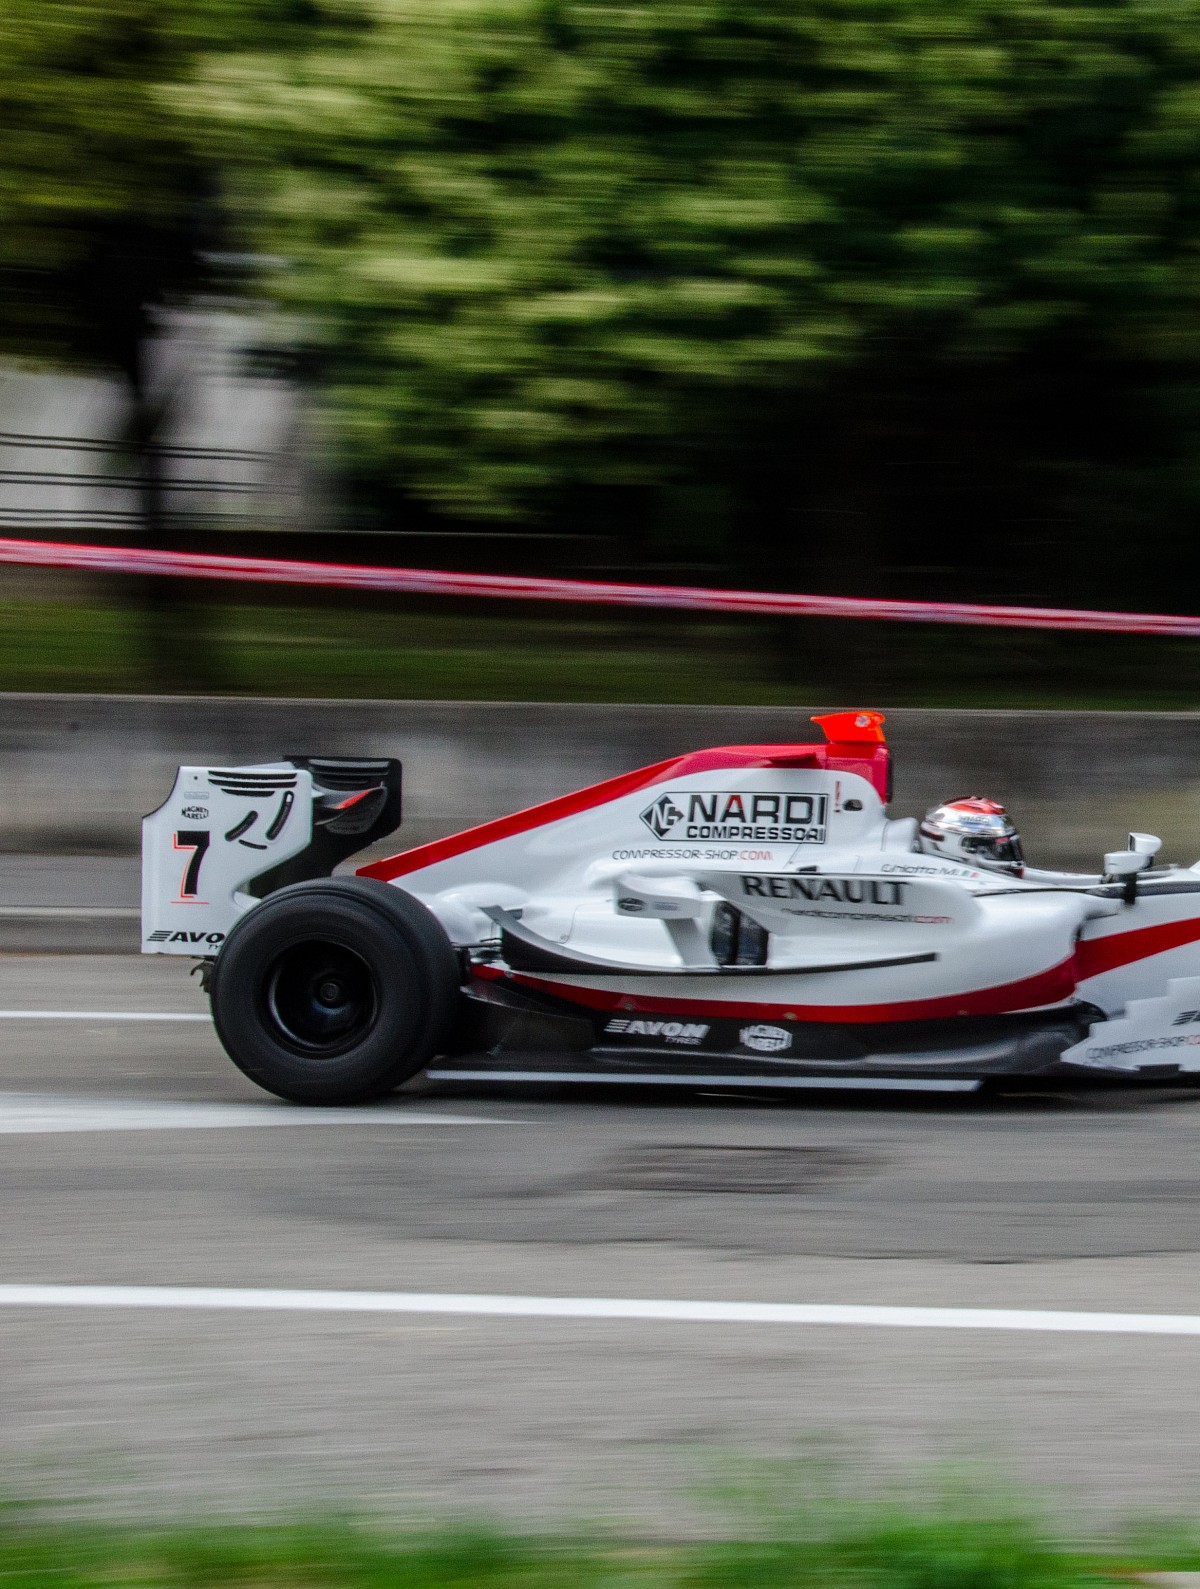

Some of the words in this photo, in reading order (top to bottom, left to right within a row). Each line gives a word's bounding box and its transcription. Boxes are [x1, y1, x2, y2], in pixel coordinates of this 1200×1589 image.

[687, 795, 825, 825] NARDI
[686, 826, 824, 841] COMPRESSORI
[173, 830, 210, 898] 7
[612, 849, 773, 861] COMPRESSOR-SHOP.COM
[739, 875, 911, 906] RENAULT
[624, 1020, 710, 1039] AVON
